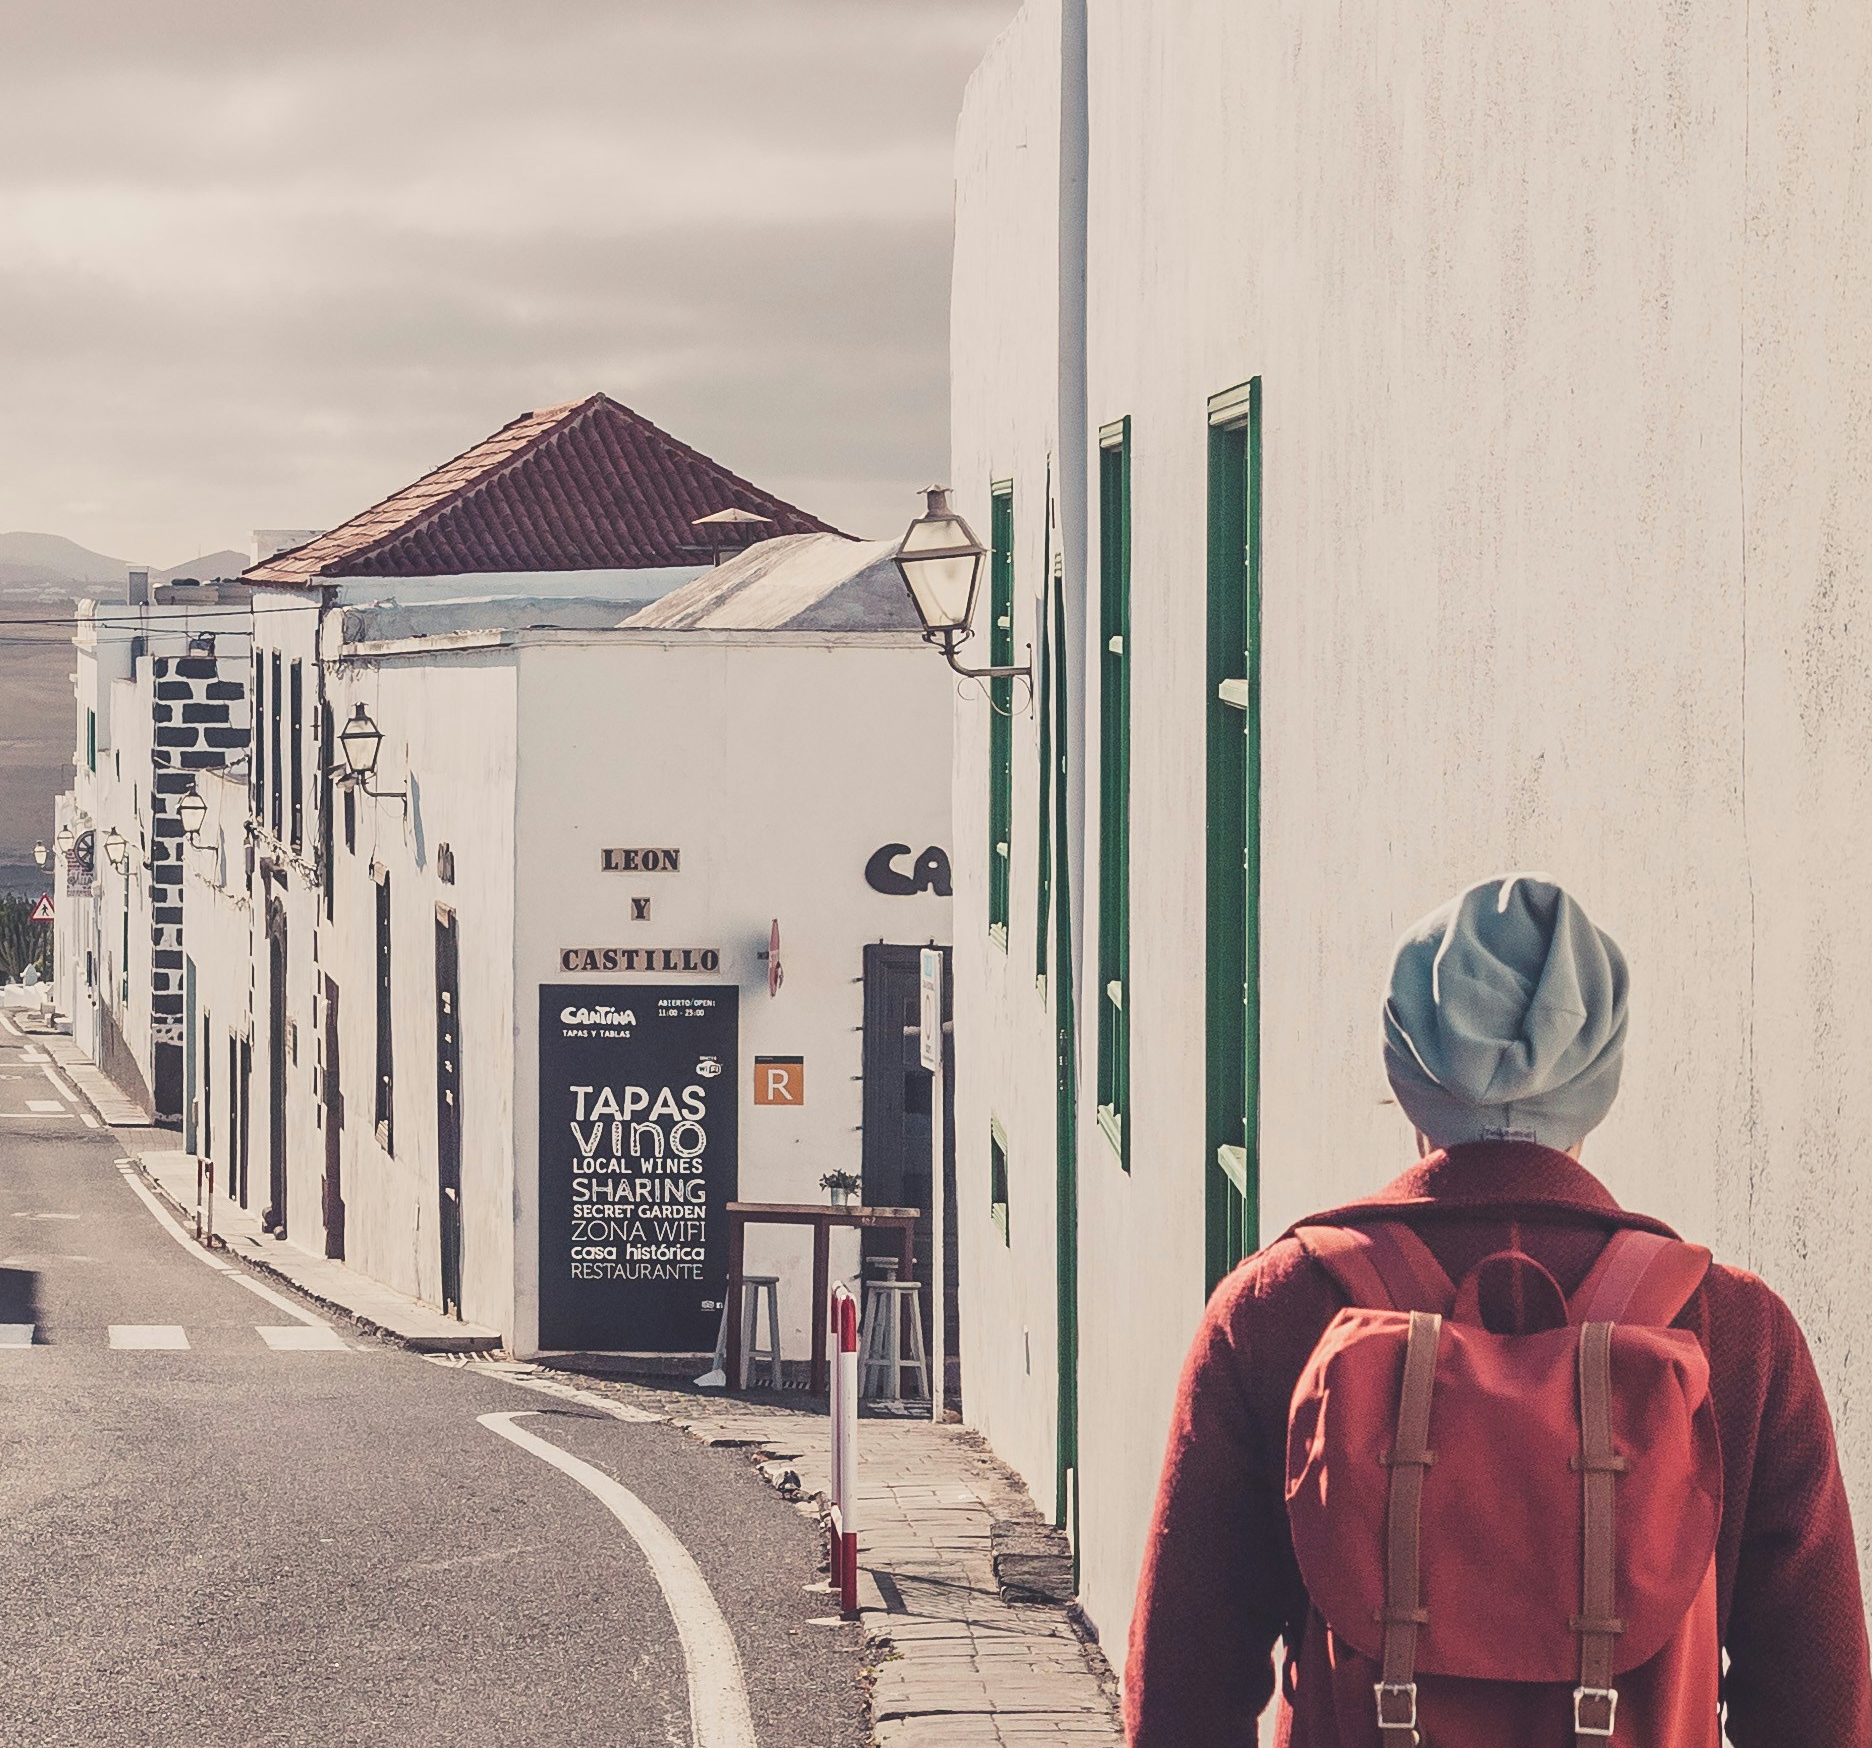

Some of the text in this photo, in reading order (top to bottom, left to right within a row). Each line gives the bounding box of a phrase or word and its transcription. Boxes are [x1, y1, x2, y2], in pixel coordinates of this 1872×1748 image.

[603, 850, 679, 870] LEON
[632, 899, 650, 919] Y
[563, 950, 718, 970] CASTILLO
[562, 1029, 631, 1038] TAPAS Y TABLAS
[767, 1069, 794, 1101] R
[570, 1086, 705, 1121] TAPAS
[573, 1158, 702, 1173] LOCAL WINES
[573, 1178, 705, 1203] SHARING
[574, 1204, 706, 1218] SECRET GARDEN
[572, 1220, 705, 1241] ZONA WIFI
[571, 1243, 704, 1260] casa histórica
[571, 1263, 703, 1279] RESTAURANTE
